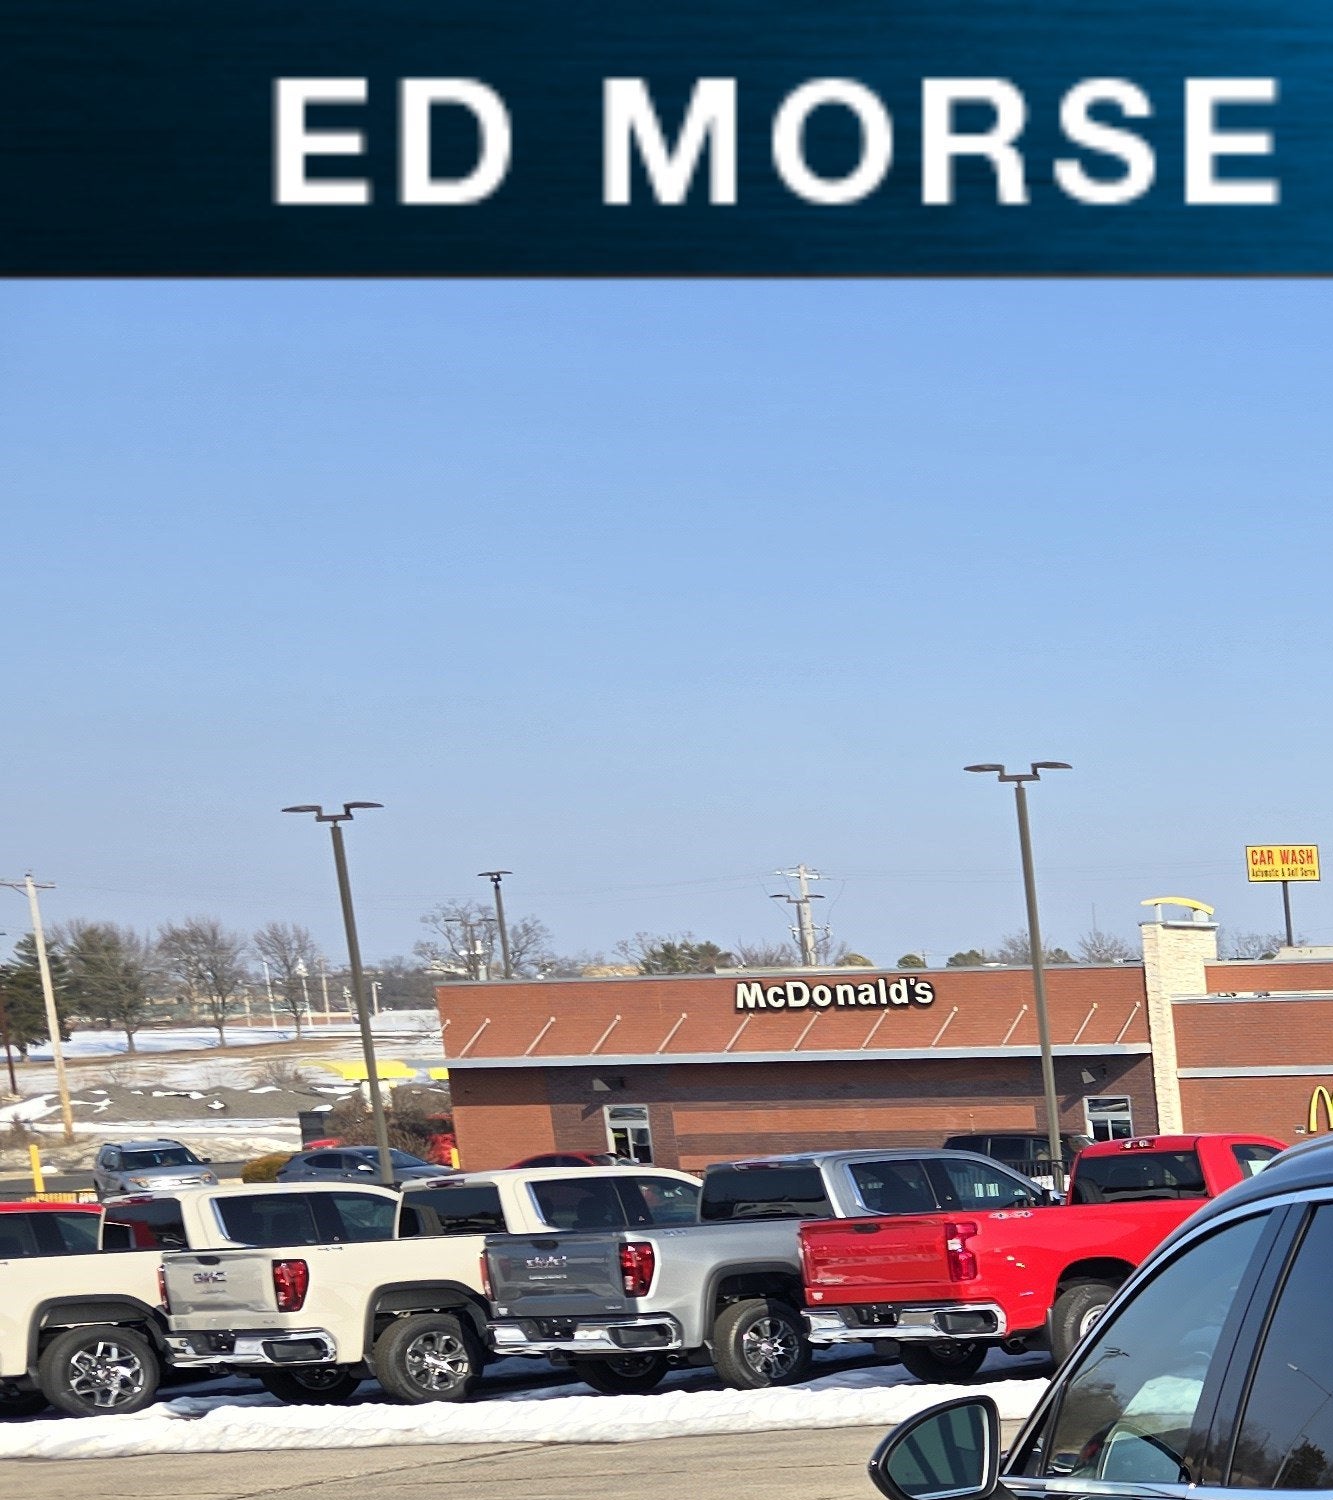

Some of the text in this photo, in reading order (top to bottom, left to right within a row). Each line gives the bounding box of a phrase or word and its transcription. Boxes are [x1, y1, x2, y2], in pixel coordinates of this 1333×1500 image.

[1251, 849, 1314, 865] CAR WASH
[735, 977, 934, 1010] McDonald's
